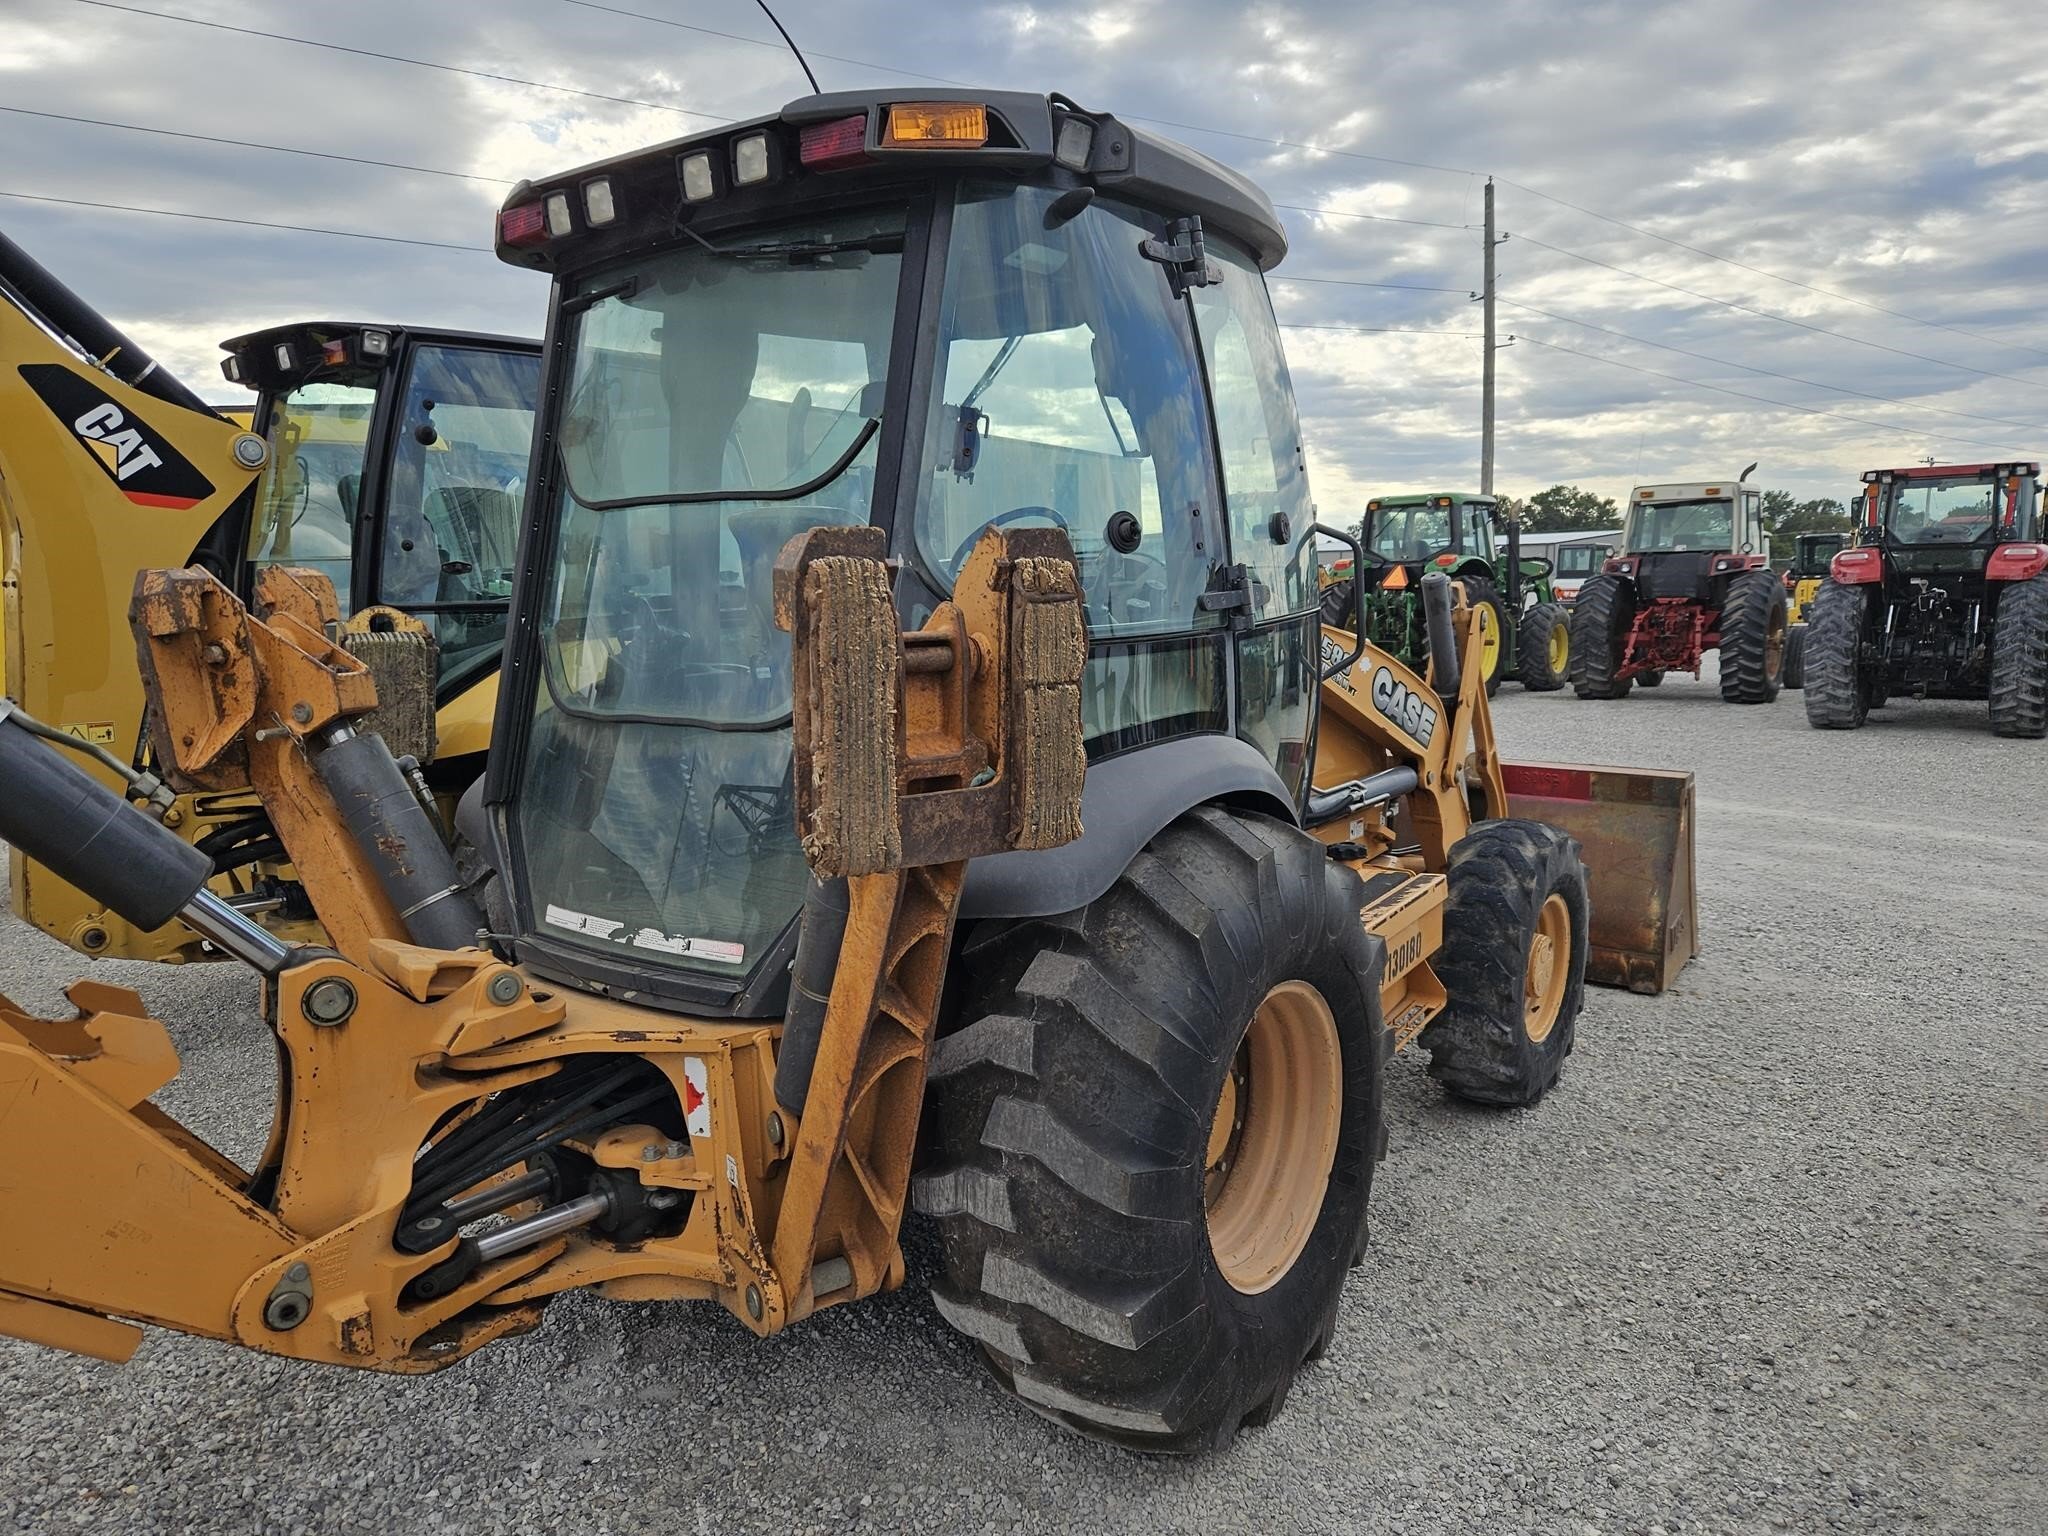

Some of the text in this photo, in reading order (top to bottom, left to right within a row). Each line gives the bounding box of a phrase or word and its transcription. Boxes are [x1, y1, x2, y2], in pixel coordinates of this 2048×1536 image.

[74, 402, 163, 481] CAT
[1372, 666, 1437, 749] CASE
[1382, 931, 1422, 985] 130180
